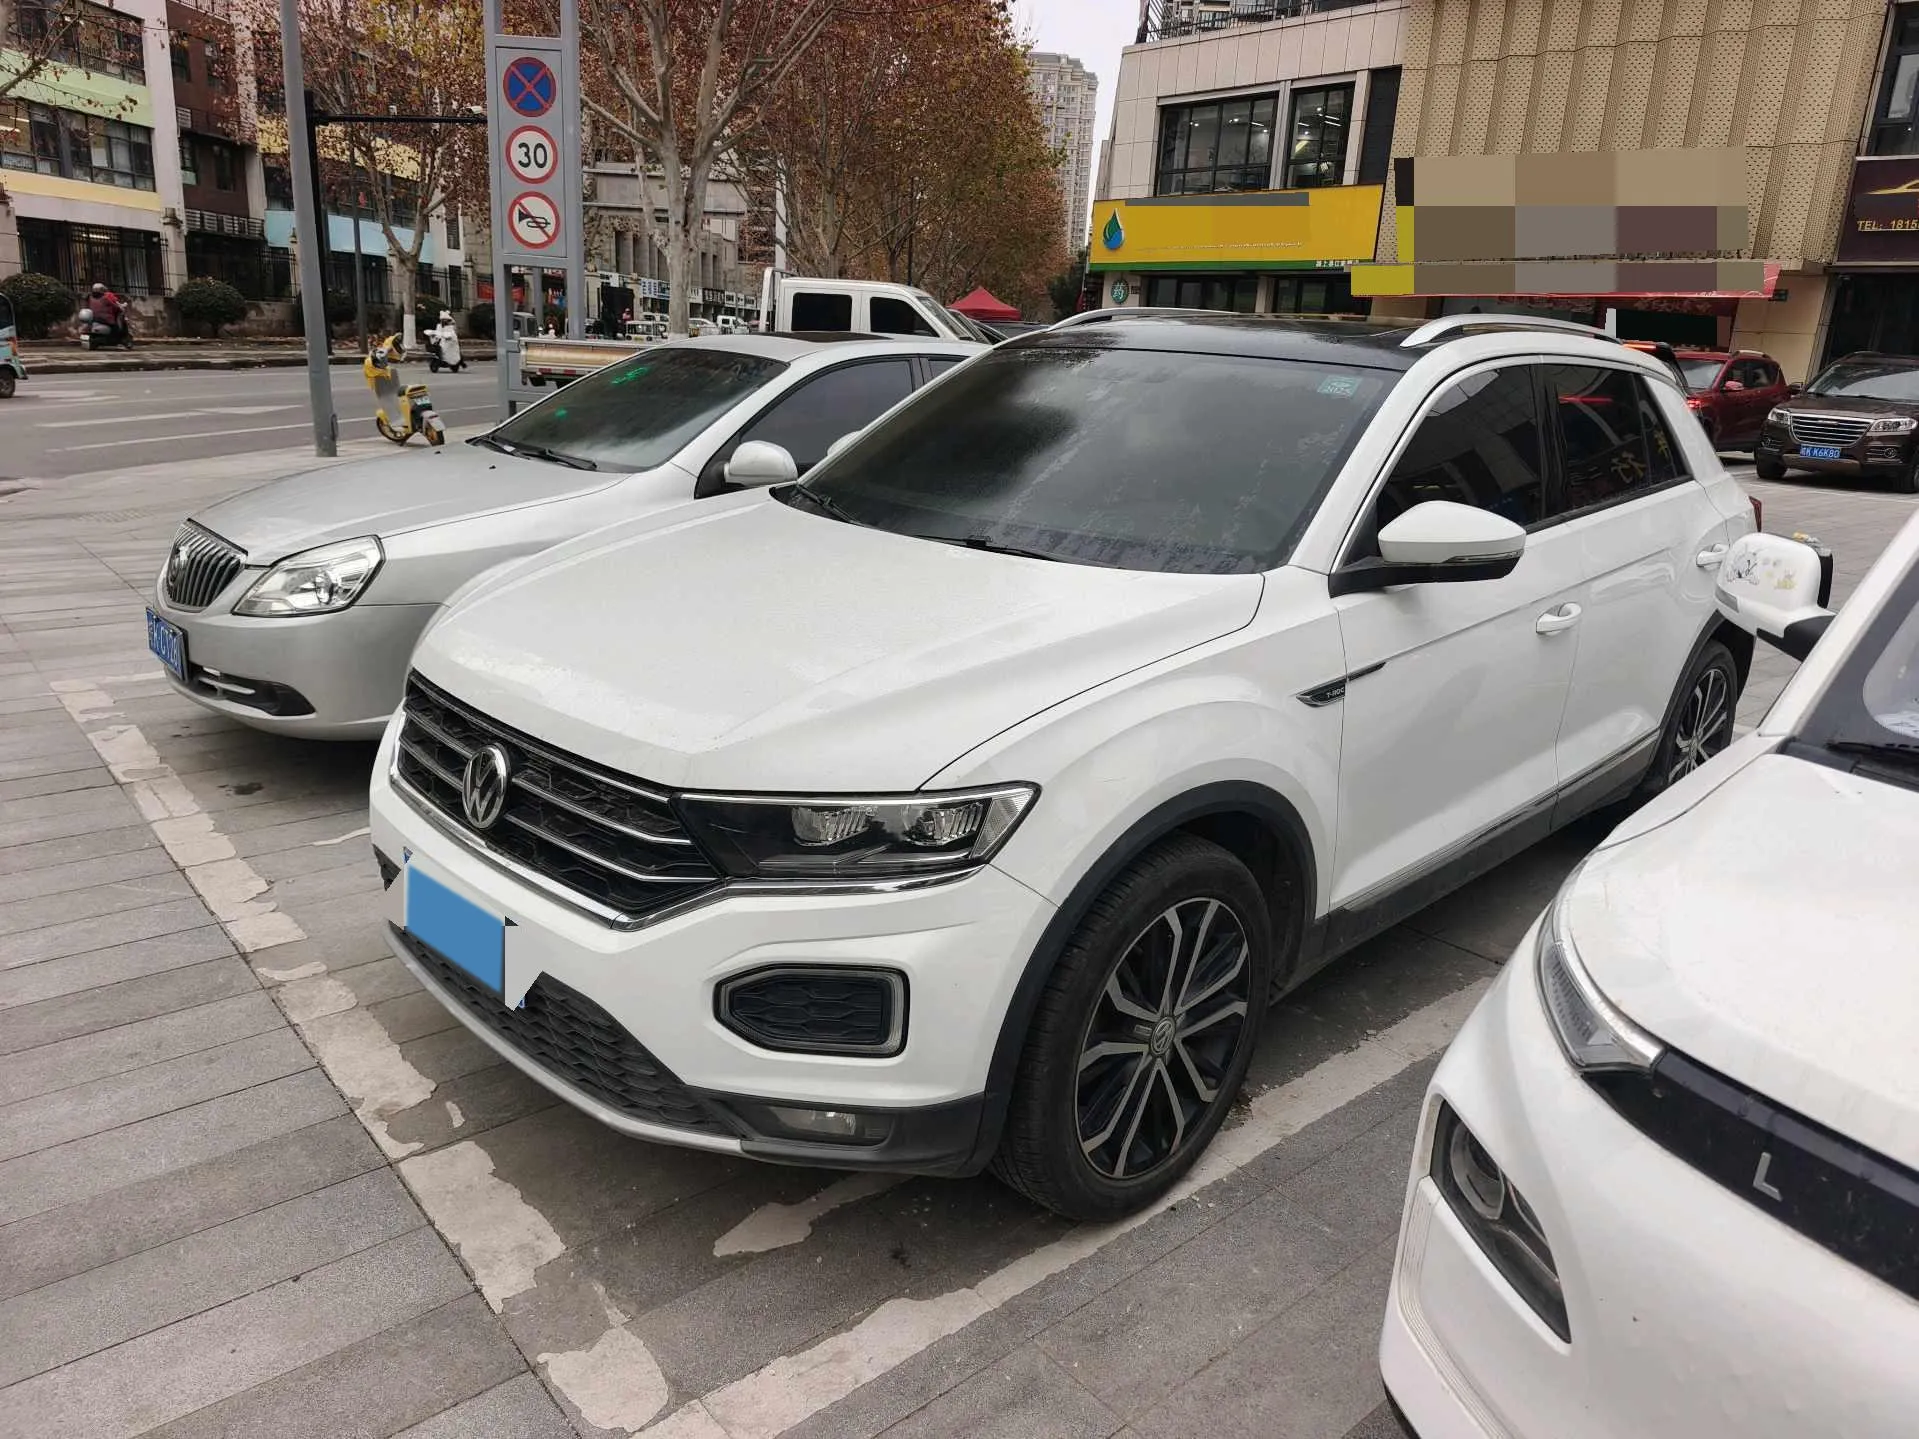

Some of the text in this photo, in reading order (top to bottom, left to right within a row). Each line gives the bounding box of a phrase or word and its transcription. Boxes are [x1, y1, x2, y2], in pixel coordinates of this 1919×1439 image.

[517, 142, 548, 169] 30
[1890, 219, 1919, 230] 1815
[1112, 282, 1126, 300] 药
[1752, 1151, 1783, 1202] L
